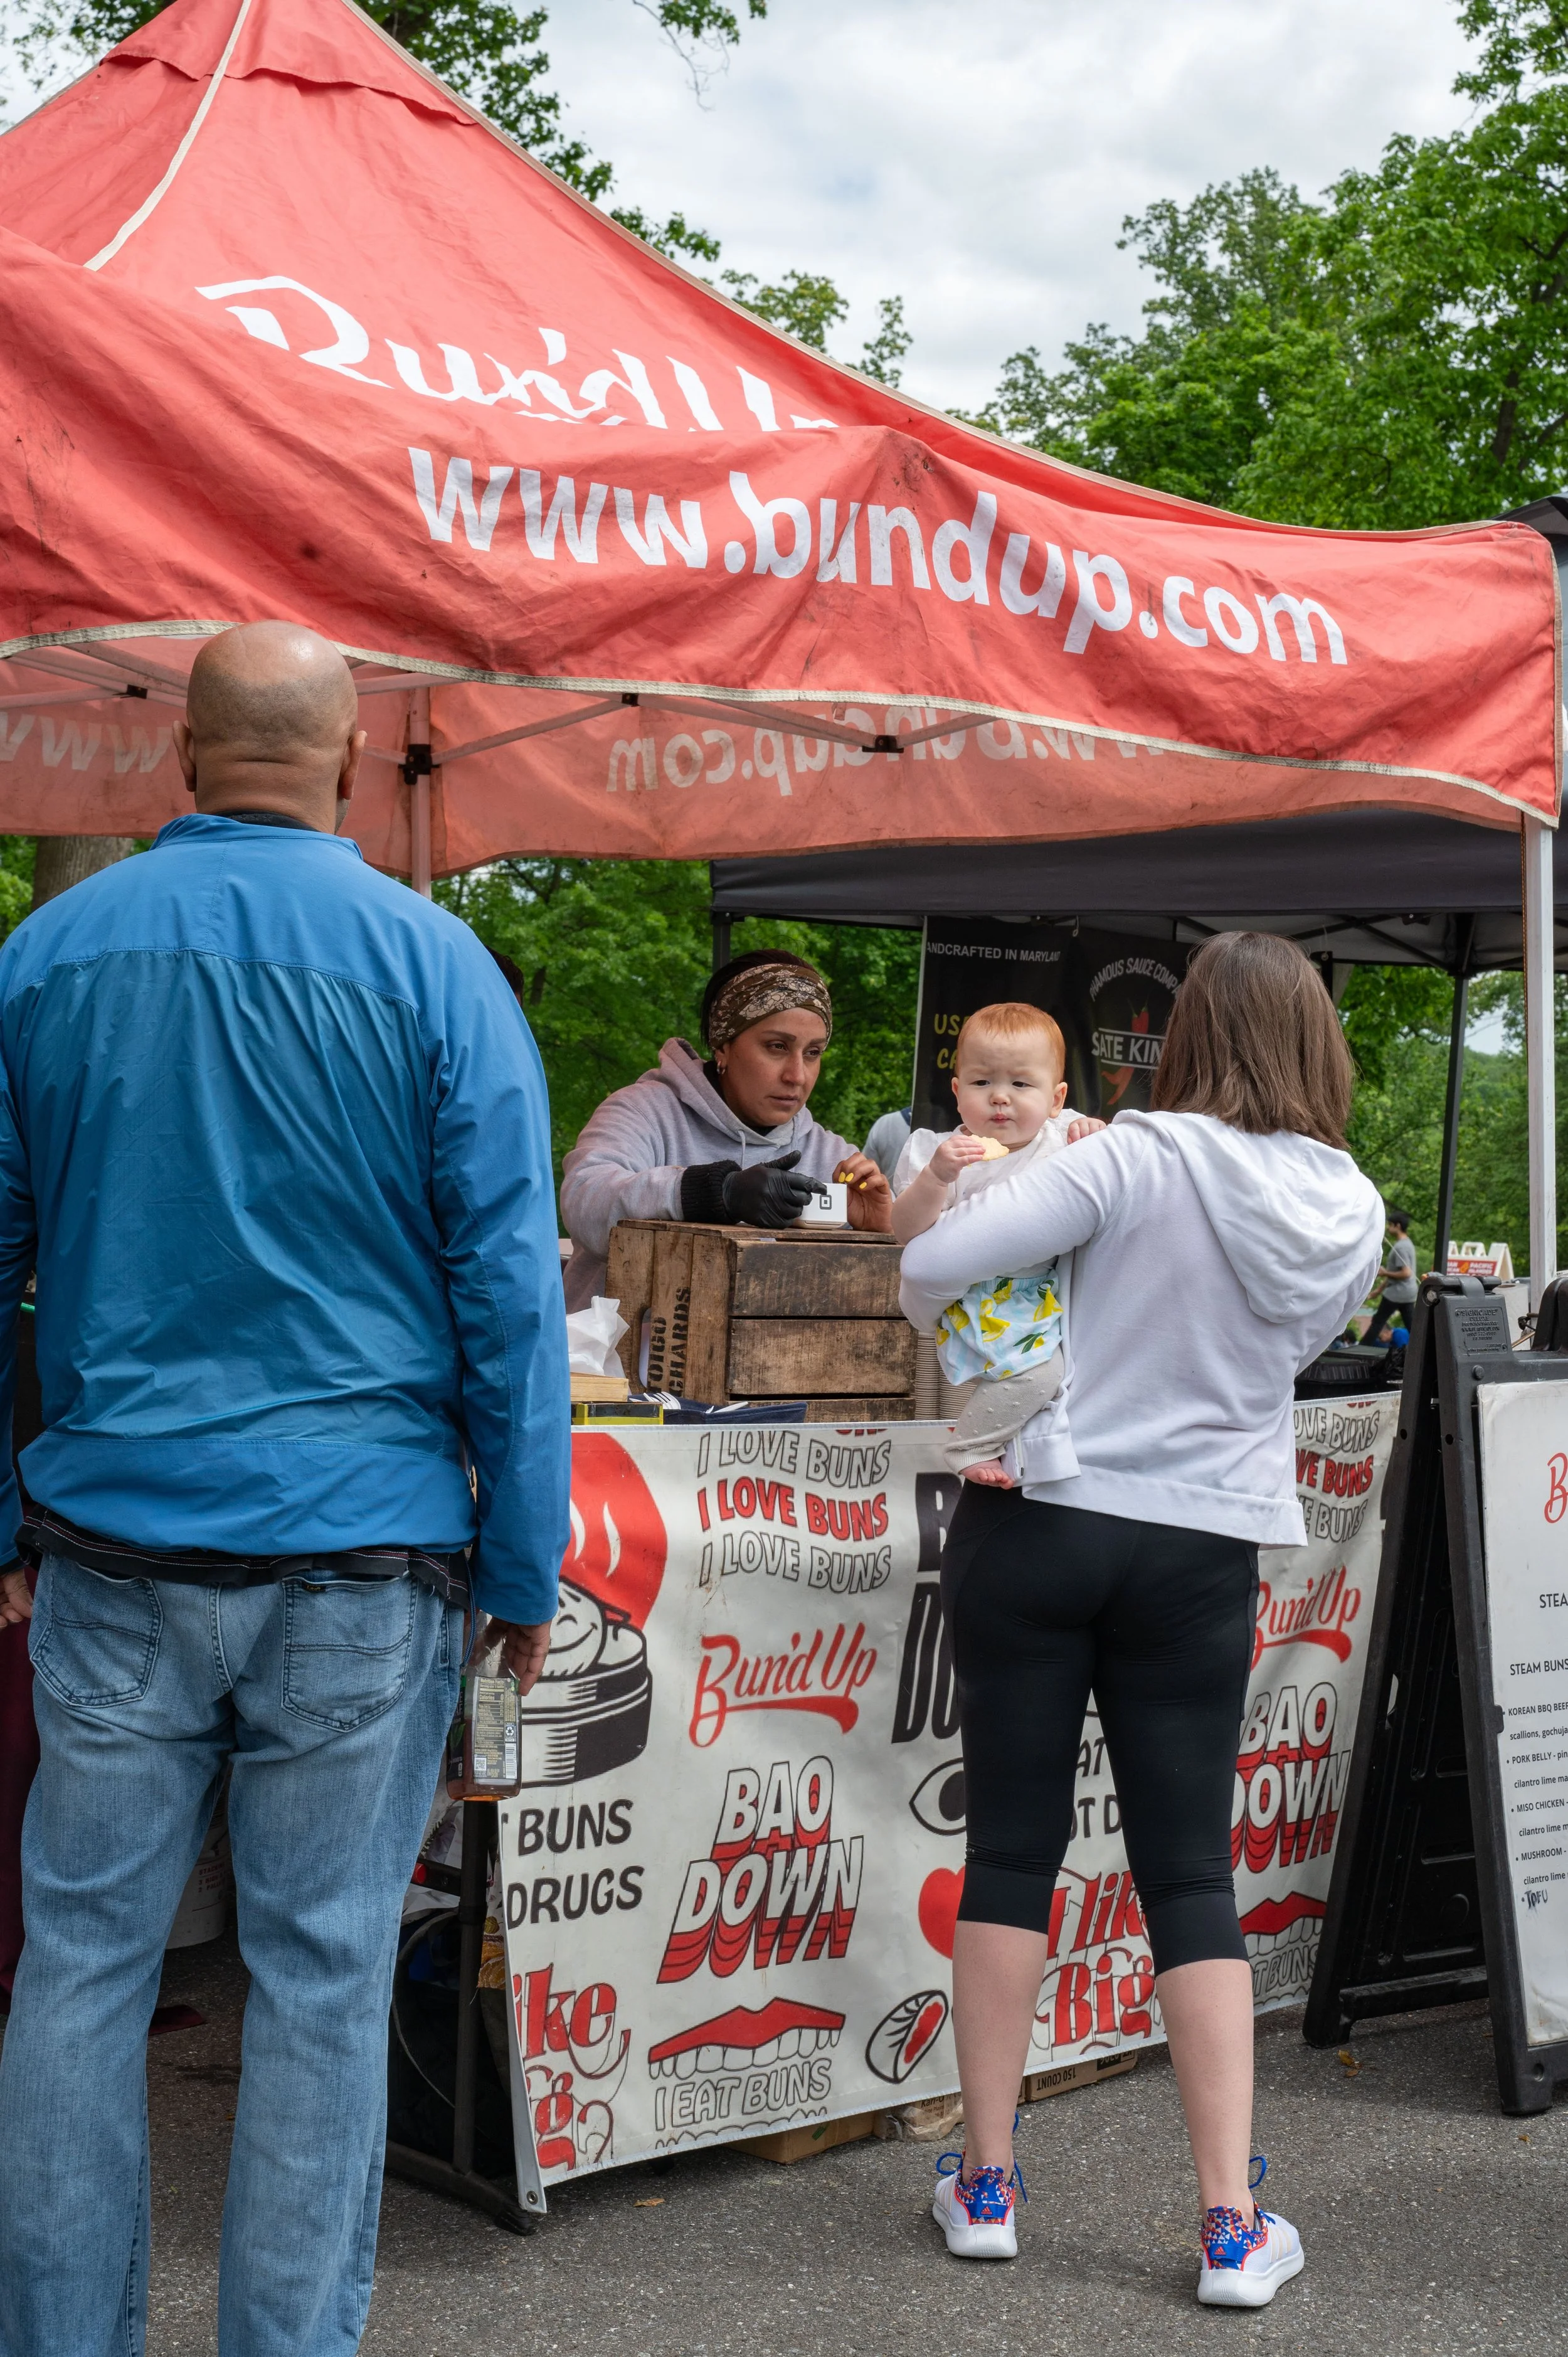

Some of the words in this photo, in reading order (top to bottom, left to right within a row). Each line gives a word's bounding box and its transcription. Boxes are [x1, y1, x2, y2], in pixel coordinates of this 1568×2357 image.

[408, 446, 1347, 665] www.bundup.com
[1005, 949, 1017, 960] IN
[1089, 959, 1124, 1002] PHAMOUS
[1126, 957, 1155, 976] SAUCE
[1091, 1031, 1124, 1060] SATE
[1330, 1410, 1380, 1453] BUNS
[697, 1432, 711, 1478] I
[719, 1430, 800, 1474] LOVE
[806, 1439, 892, 1489] BUNS
[1296, 1448, 1321, 1488] VE
[1323, 1454, 1374, 1498] BUNS
[697, 1487, 711, 1532] I
[717, 1476, 798, 1528] LOVE
[805, 1492, 889, 1542] BUNS
[1315, 1499, 1368, 1543] BUNS
[699, 1541, 712, 1588] I
[721, 1531, 800, 1582] LOVE
[808, 1545, 891, 1595] BUNS
[1318, 1565, 1361, 1631] Up
[689, 1629, 822, 1747] Bun'd
[820, 1622, 877, 1700] Up
[1510, 1661, 1541, 1676] STEAM
[1544, 1658, 1568, 1672] BUNS
[1236, 1682, 1337, 1764] BAO
[1508, 1706, 1536, 1716] KOREAN
[1537, 1704, 1552, 1713] BBQ
[1510, 1730, 1540, 1740] scallions,
[1542, 1726, 1568, 1738] gochuja
[1512, 1754, 1530, 1764] PORK
[1532, 1752, 1552, 1762] BELLY
[1557, 1750, 1568, 1760] pin
[1514, 1779, 1540, 1789] cilantro
[1541, 1776, 1556, 1785] lime
[709, 1755, 835, 1859] BAO
[1517, 1802, 1534, 1812] MISO
[1535, 1798, 1565, 1810] CHICKEN
[517, 1799, 633, 1856] BUNS
[1518, 1827, 1545, 1837] cilantro
[1546, 1824, 1561, 1833] lime
[1521, 1847, 1562, 1861] MUSHROOM
[507, 1866, 645, 1930] DRUGS
[1523, 1874, 1549, 1885] cilantro
[1550, 1872, 1566, 1881] lime
[656, 1835, 864, 1984] DOWN
[1036, 1947, 1155, 2047] Big
[655, 2086, 666, 2132] I
[671, 2077, 742, 2127] EAT
[741, 2057, 832, 2115] BUNS
[1037, 2072, 1061, 2091] COUNT
[1063, 2067, 1077, 2082] 150
